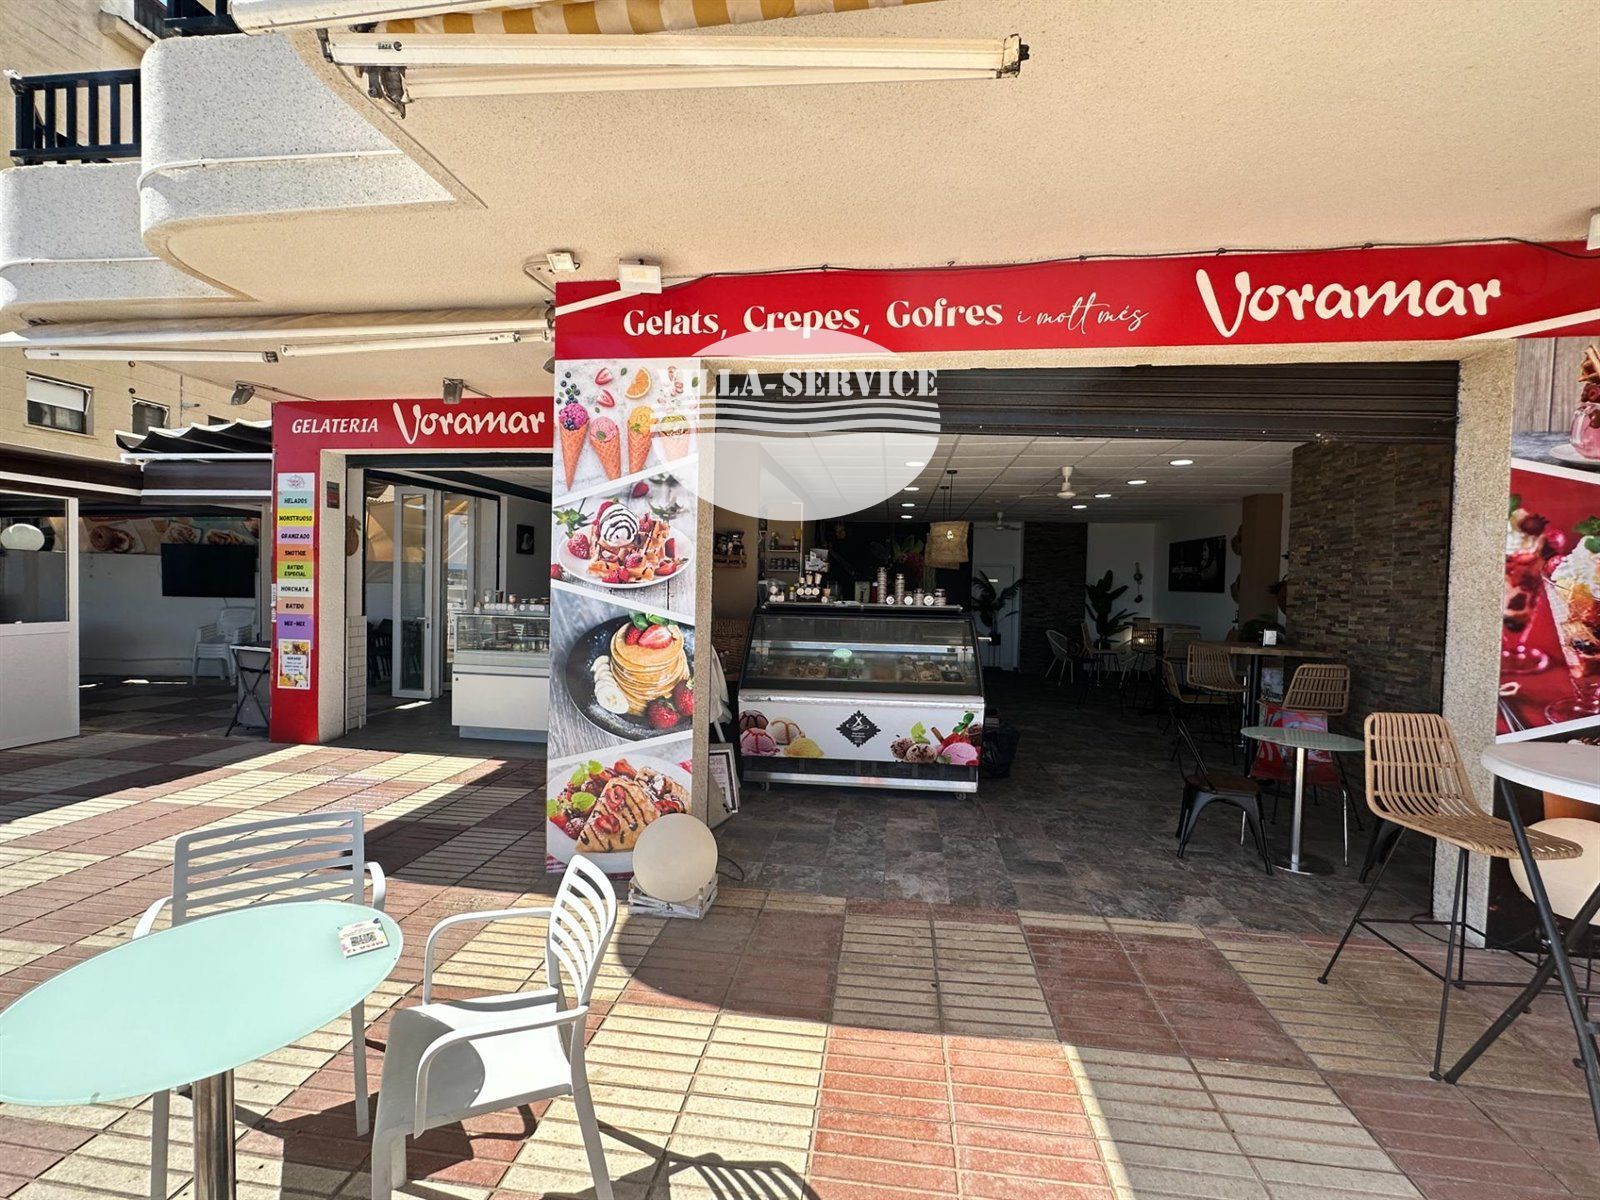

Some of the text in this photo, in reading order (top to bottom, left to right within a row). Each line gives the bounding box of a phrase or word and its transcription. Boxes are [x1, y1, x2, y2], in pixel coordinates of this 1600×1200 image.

[623, 291, 1150, 340] Gelats, Crepes, Gofres i molt més
[1196, 269, 1501, 338] Voramar
[291, 402, 546, 445] GELATERIA Voramar
